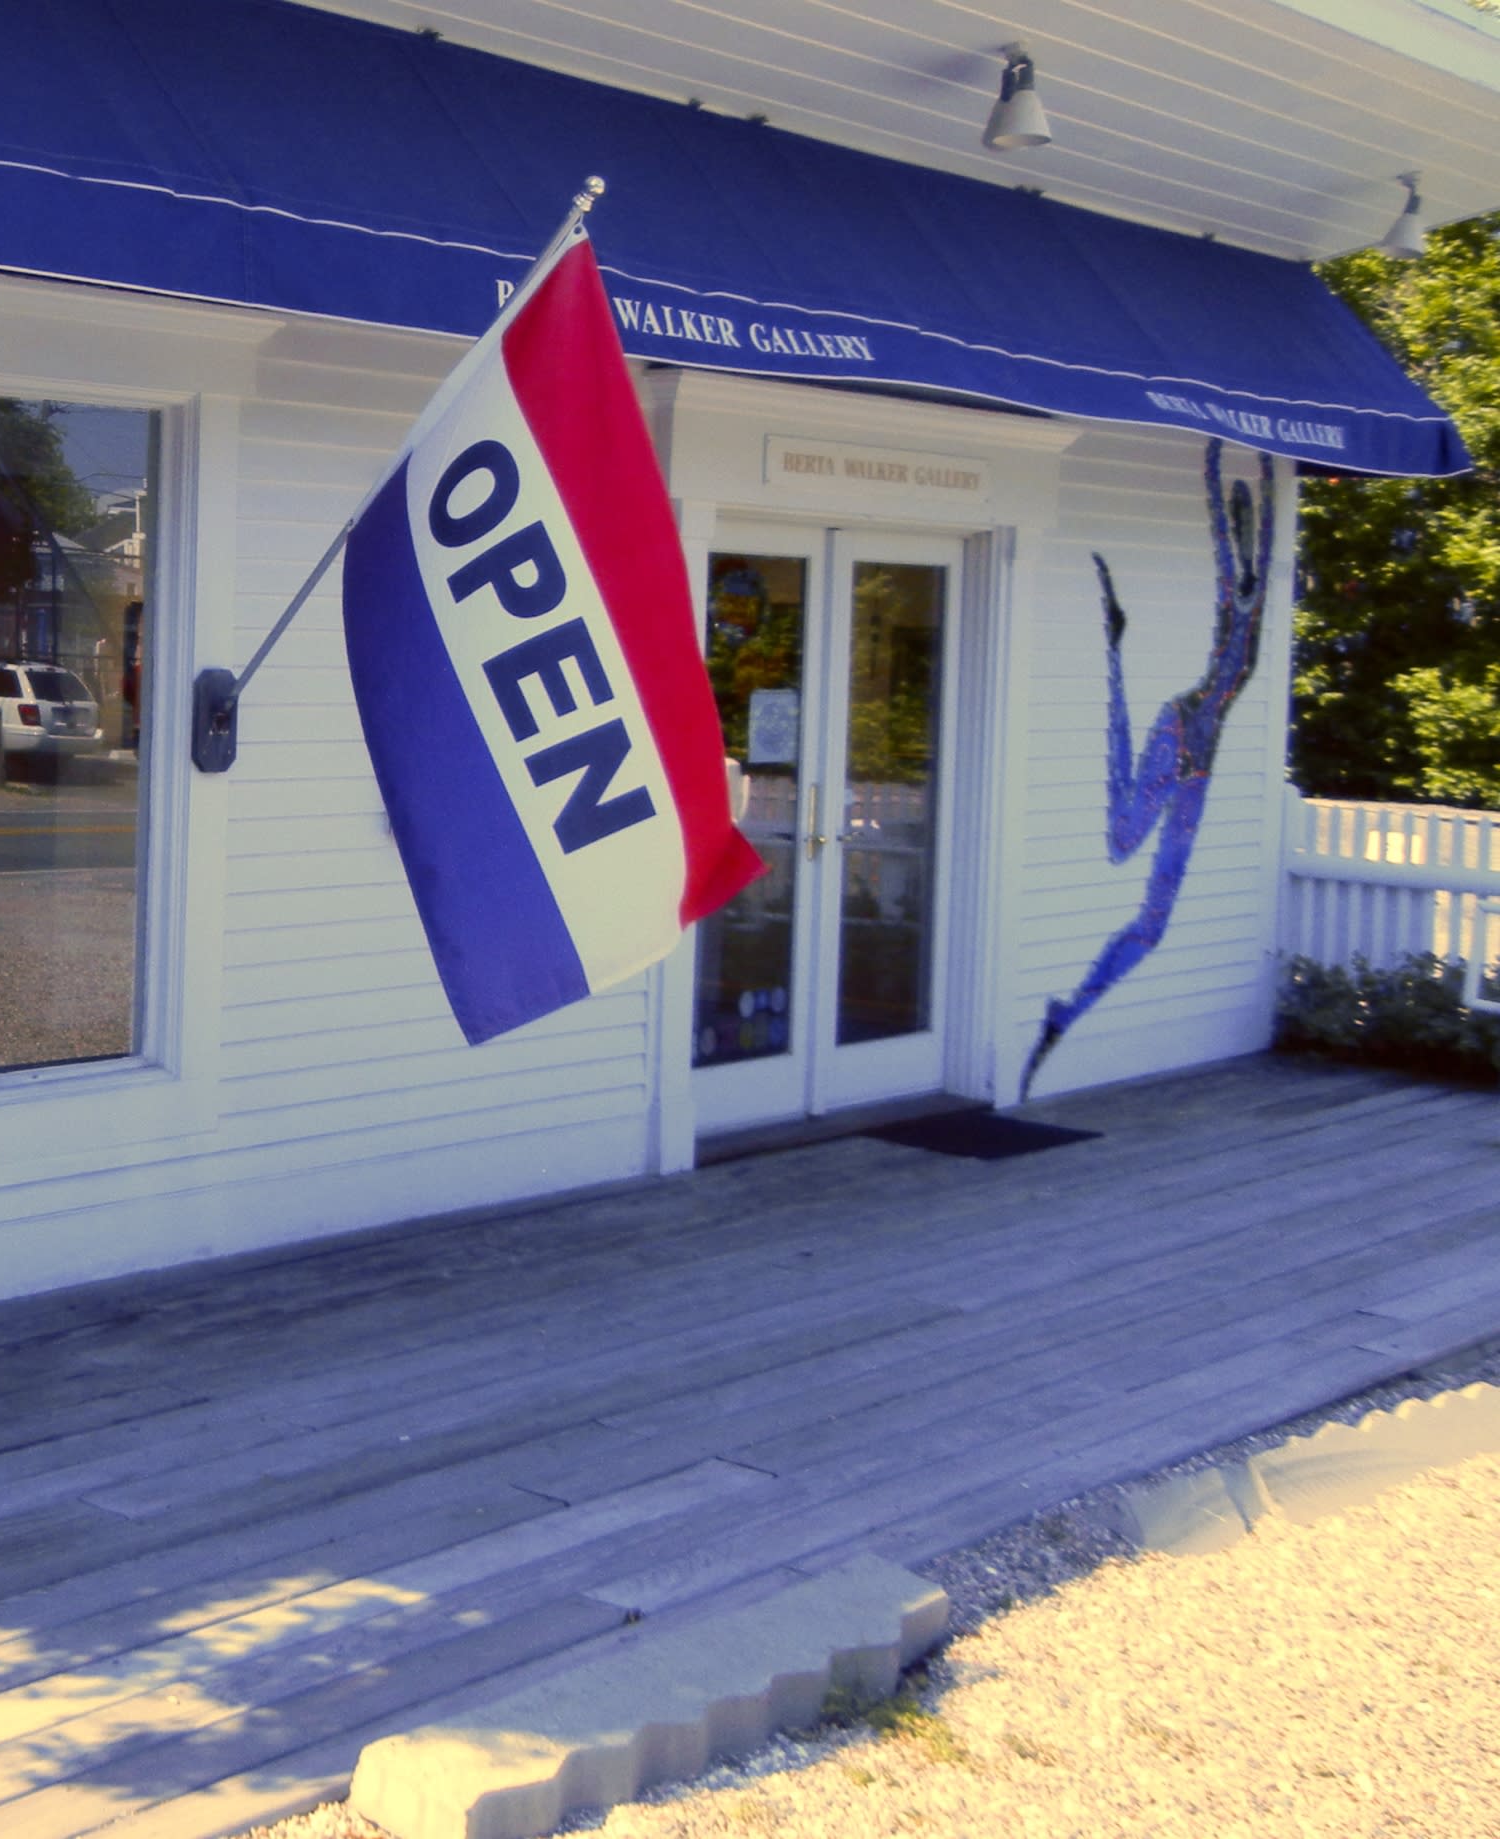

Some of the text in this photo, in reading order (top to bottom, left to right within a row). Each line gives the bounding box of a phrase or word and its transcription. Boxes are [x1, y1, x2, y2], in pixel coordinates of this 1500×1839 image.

[613, 297, 875, 361] WALKER GALLERY
[1277, 419, 1346, 449] GALLERY
[844, 459, 908, 484] WALKER
[915, 467, 981, 491] GALLERY
[429, 439, 657, 855] OPEN
